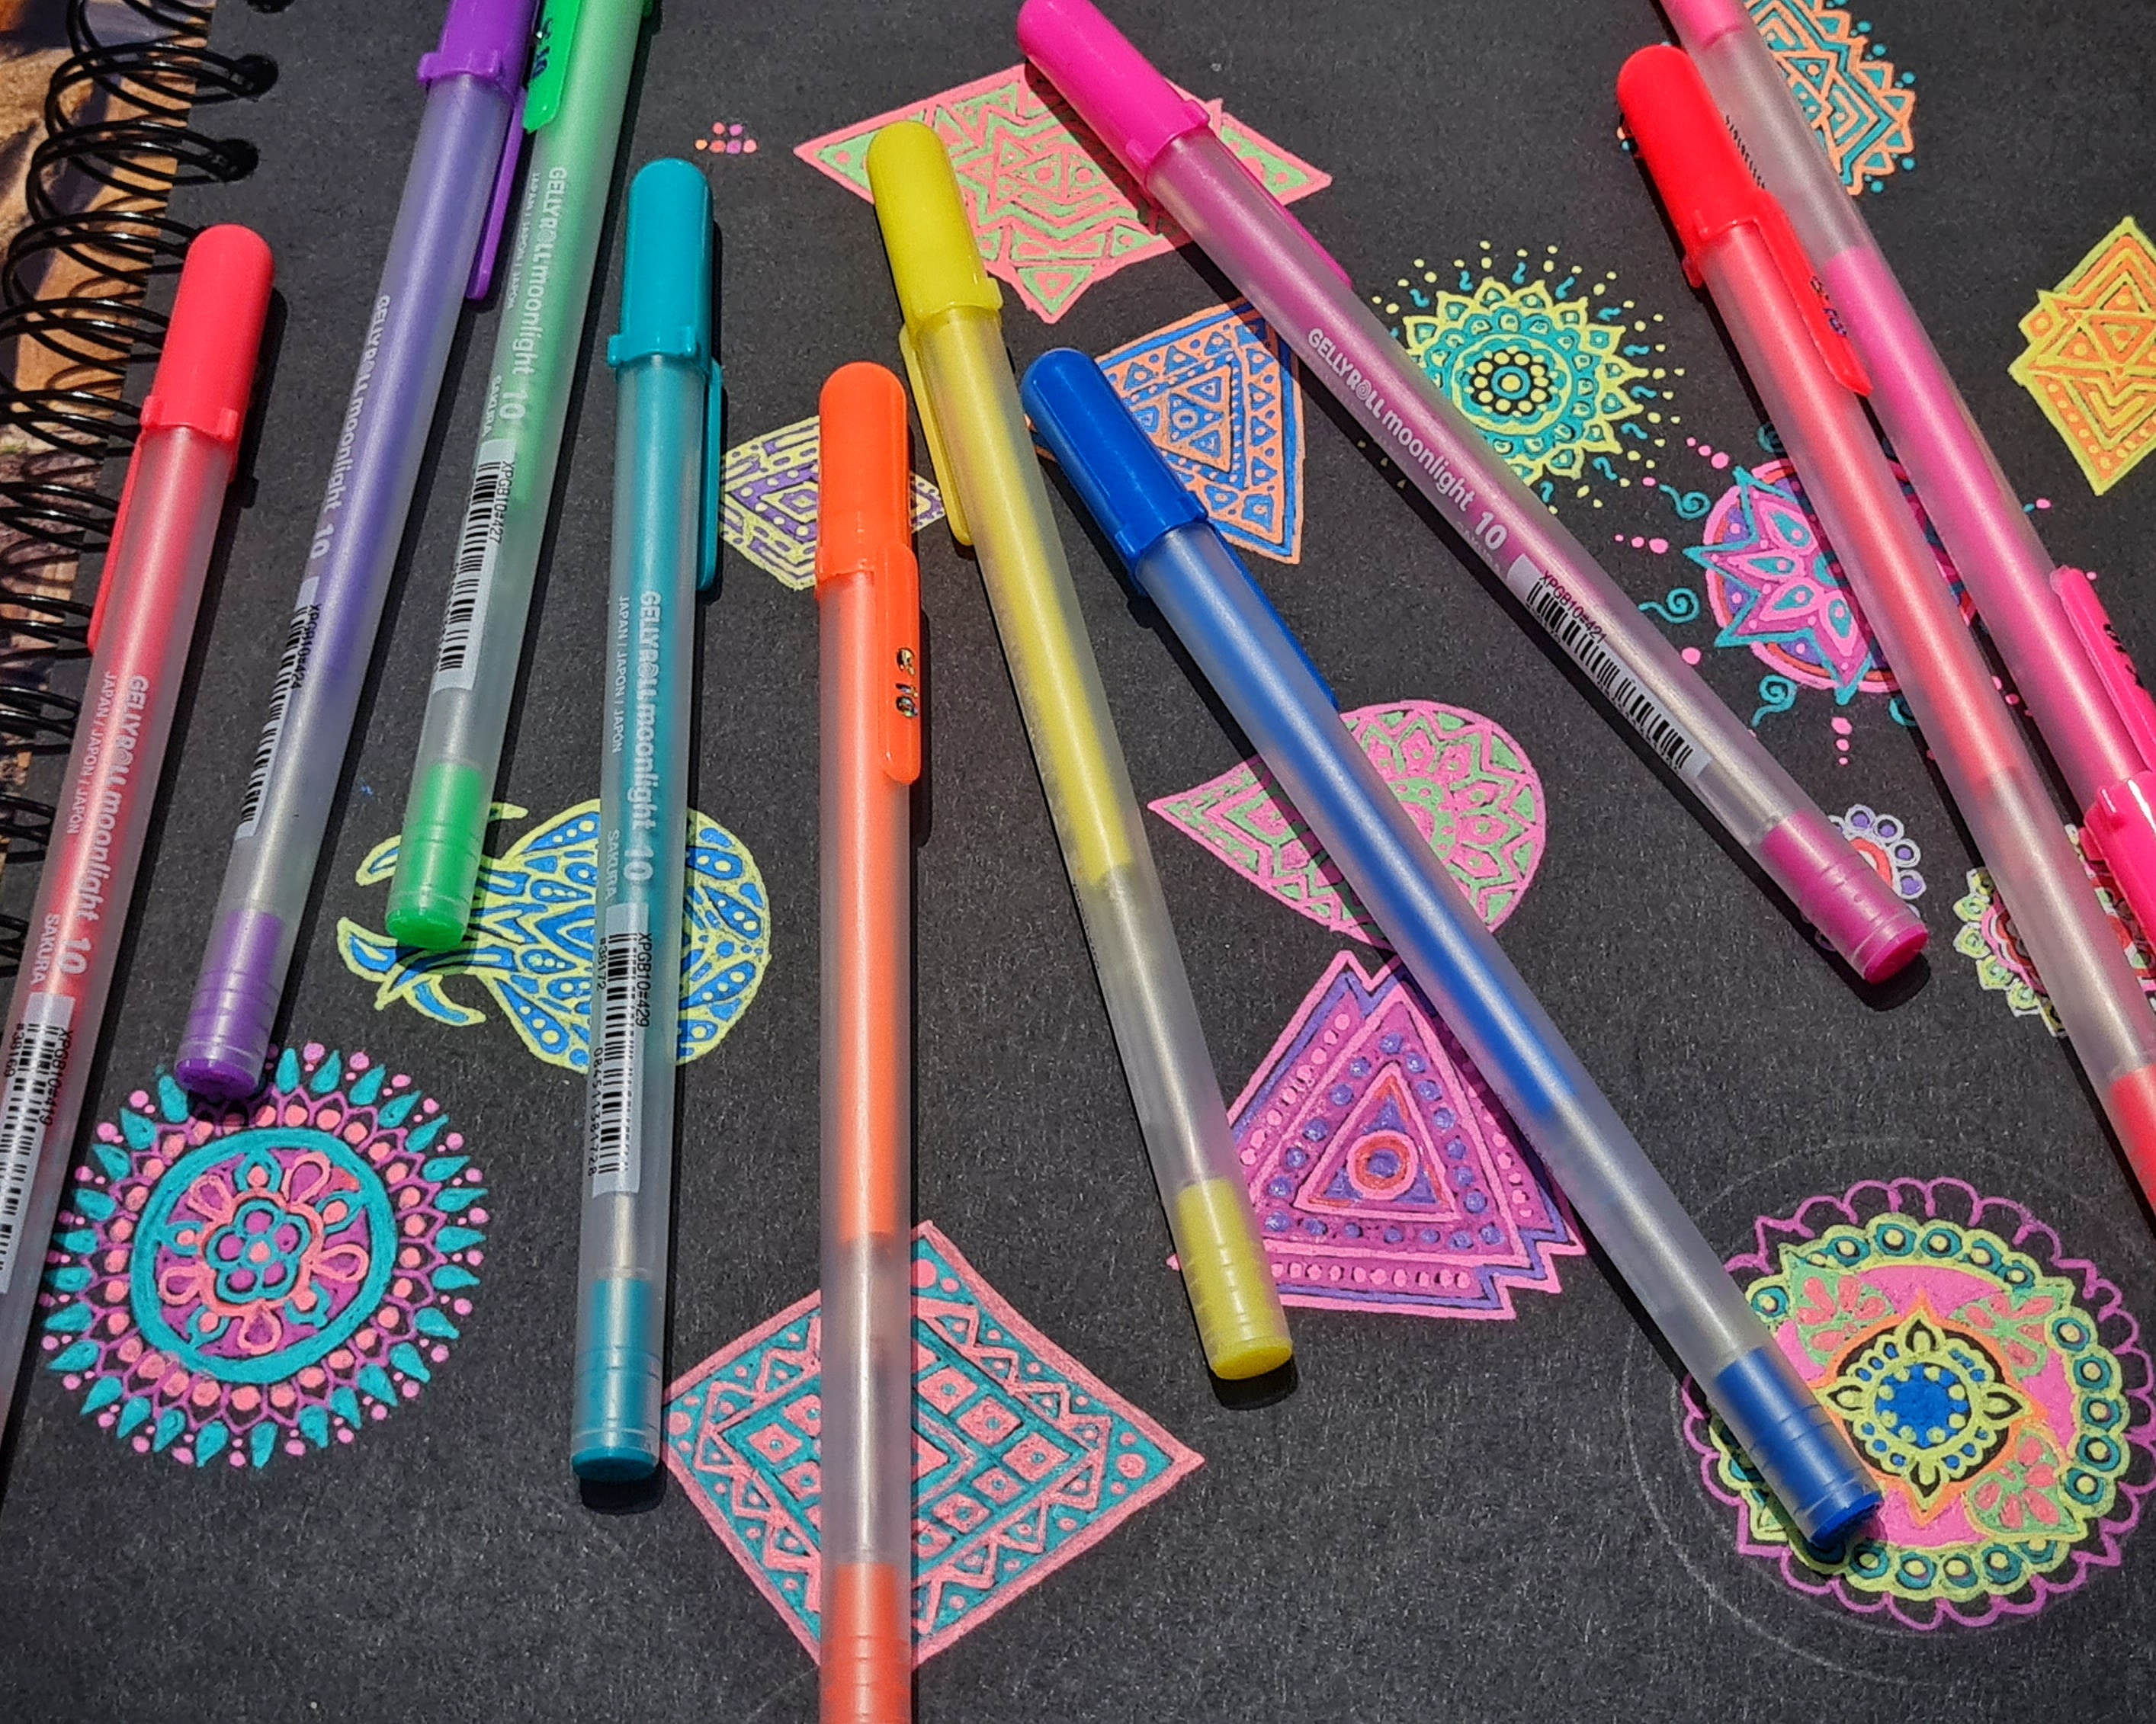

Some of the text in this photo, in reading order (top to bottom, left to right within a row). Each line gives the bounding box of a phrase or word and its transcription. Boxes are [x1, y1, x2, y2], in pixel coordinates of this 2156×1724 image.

[512, 265, 549, 375] moonlight
[481, 374, 502, 437] SAKURA
[499, 388, 528, 420] 10
[324, 396, 364, 514] moonlight
[1381, 409, 1476, 512] moonlight
[1474, 511, 1508, 550] 10
[310, 523, 335, 559] 10
[617, 595, 630, 640] JAPAN
[96, 671, 117, 719] JAPAN
[614, 650, 627, 697] JAPON
[81, 729, 104, 777] JAPON
[627, 703, 659, 830] moonlight
[76, 790, 124, 921] moonlight
[605, 828, 620, 901] SAKURA
[623, 844, 654, 882] 10
[30, 913, 59, 985] SAKURA
[56, 937, 91, 975] 10
[588, 1046, 605, 1177] 084511381728
